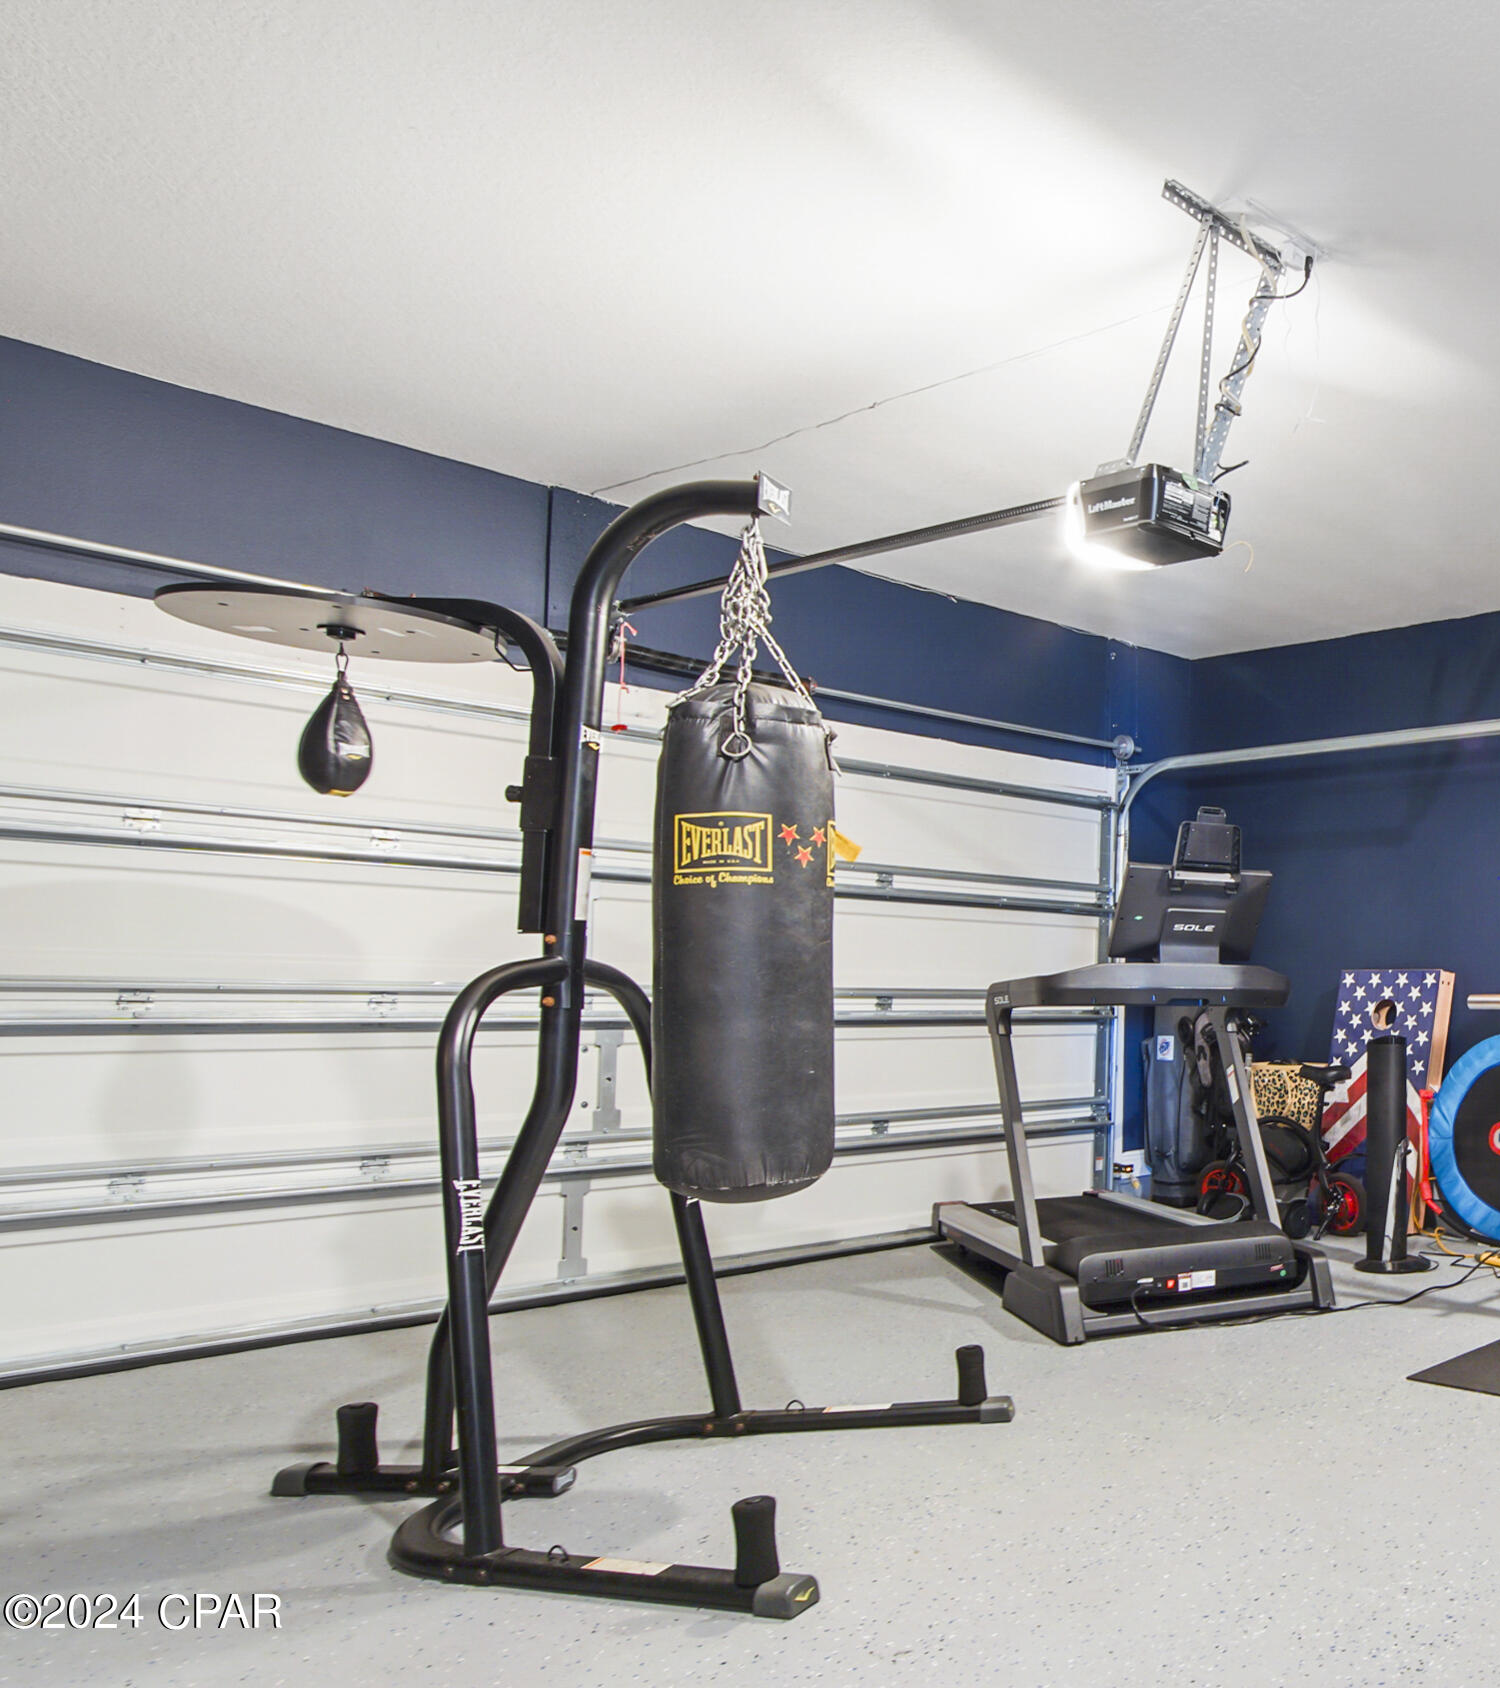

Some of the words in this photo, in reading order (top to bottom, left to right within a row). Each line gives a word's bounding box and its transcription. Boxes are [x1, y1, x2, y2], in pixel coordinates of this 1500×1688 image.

[681, 820, 765, 867] EVERLAST
[673, 875, 704, 886] Choice
[705, 874, 717, 889] of
[718, 872, 775, 887] Champions
[1173, 923, 1216, 932] SOLE
[452, 1179, 486, 1256] EVERLAST
